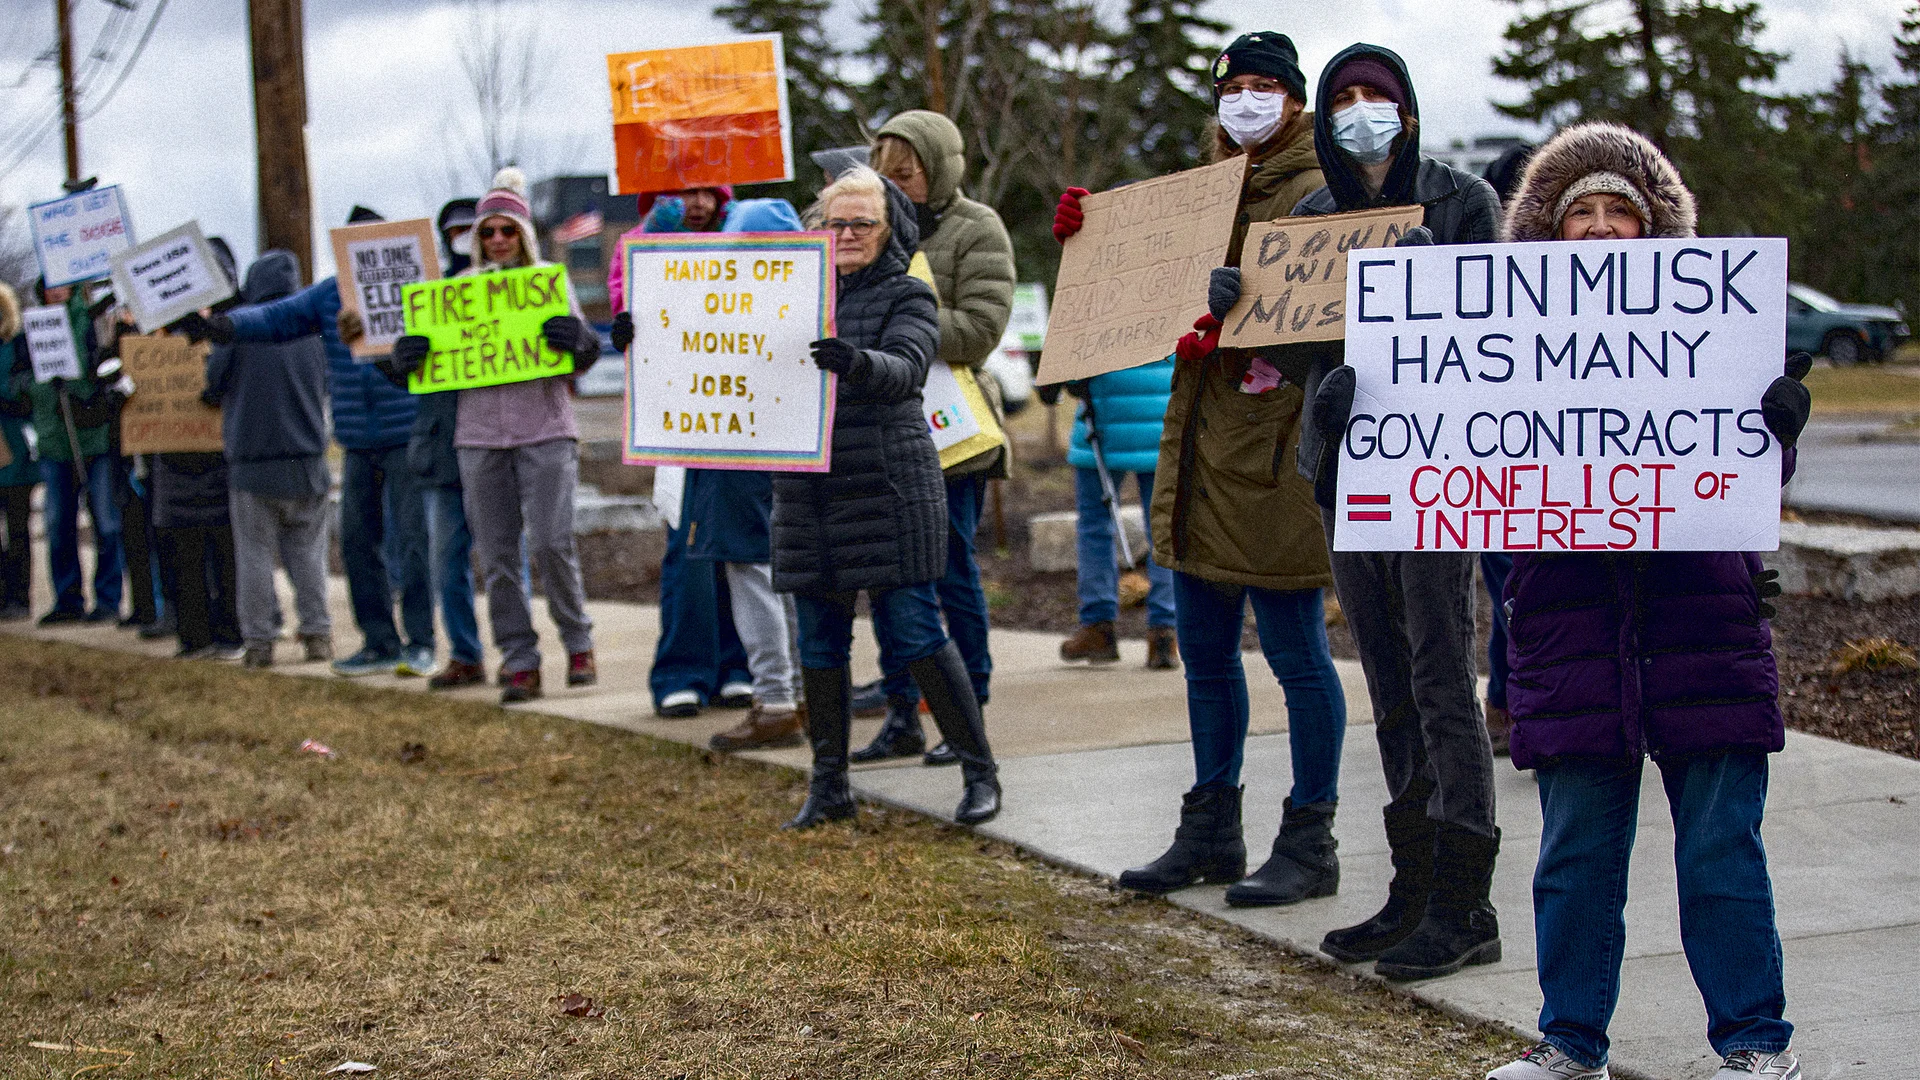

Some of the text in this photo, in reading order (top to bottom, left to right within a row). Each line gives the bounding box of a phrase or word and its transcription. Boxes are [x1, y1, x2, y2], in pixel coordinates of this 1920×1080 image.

[355, 243, 414, 269] NO ONE
[664, 259, 795, 283] HANDS OFF
[1084, 230, 1177, 275] ARE THE
[363, 282, 403, 309] ELO
[409, 270, 564, 328] FIRE MUSK
[703, 292, 754, 315] OUR
[1053, 278, 1125, 330] BAD
[1358, 247, 1758, 323] ELON MUSK
[460, 318, 501, 342] NOT
[1232, 285, 1345, 336] MUS
[681, 330, 774, 362] MONEY,
[1070, 316, 1167, 361] REMEMBER?
[1391, 330, 1711, 384] HAS MANY
[688, 373, 755, 403] JOBS,
[1345, 406, 1772, 461] GOV. CONTRACTS
[1409, 462, 1739, 509] CONFLICT OF
[1414, 506, 1676, 550] INTEREST
